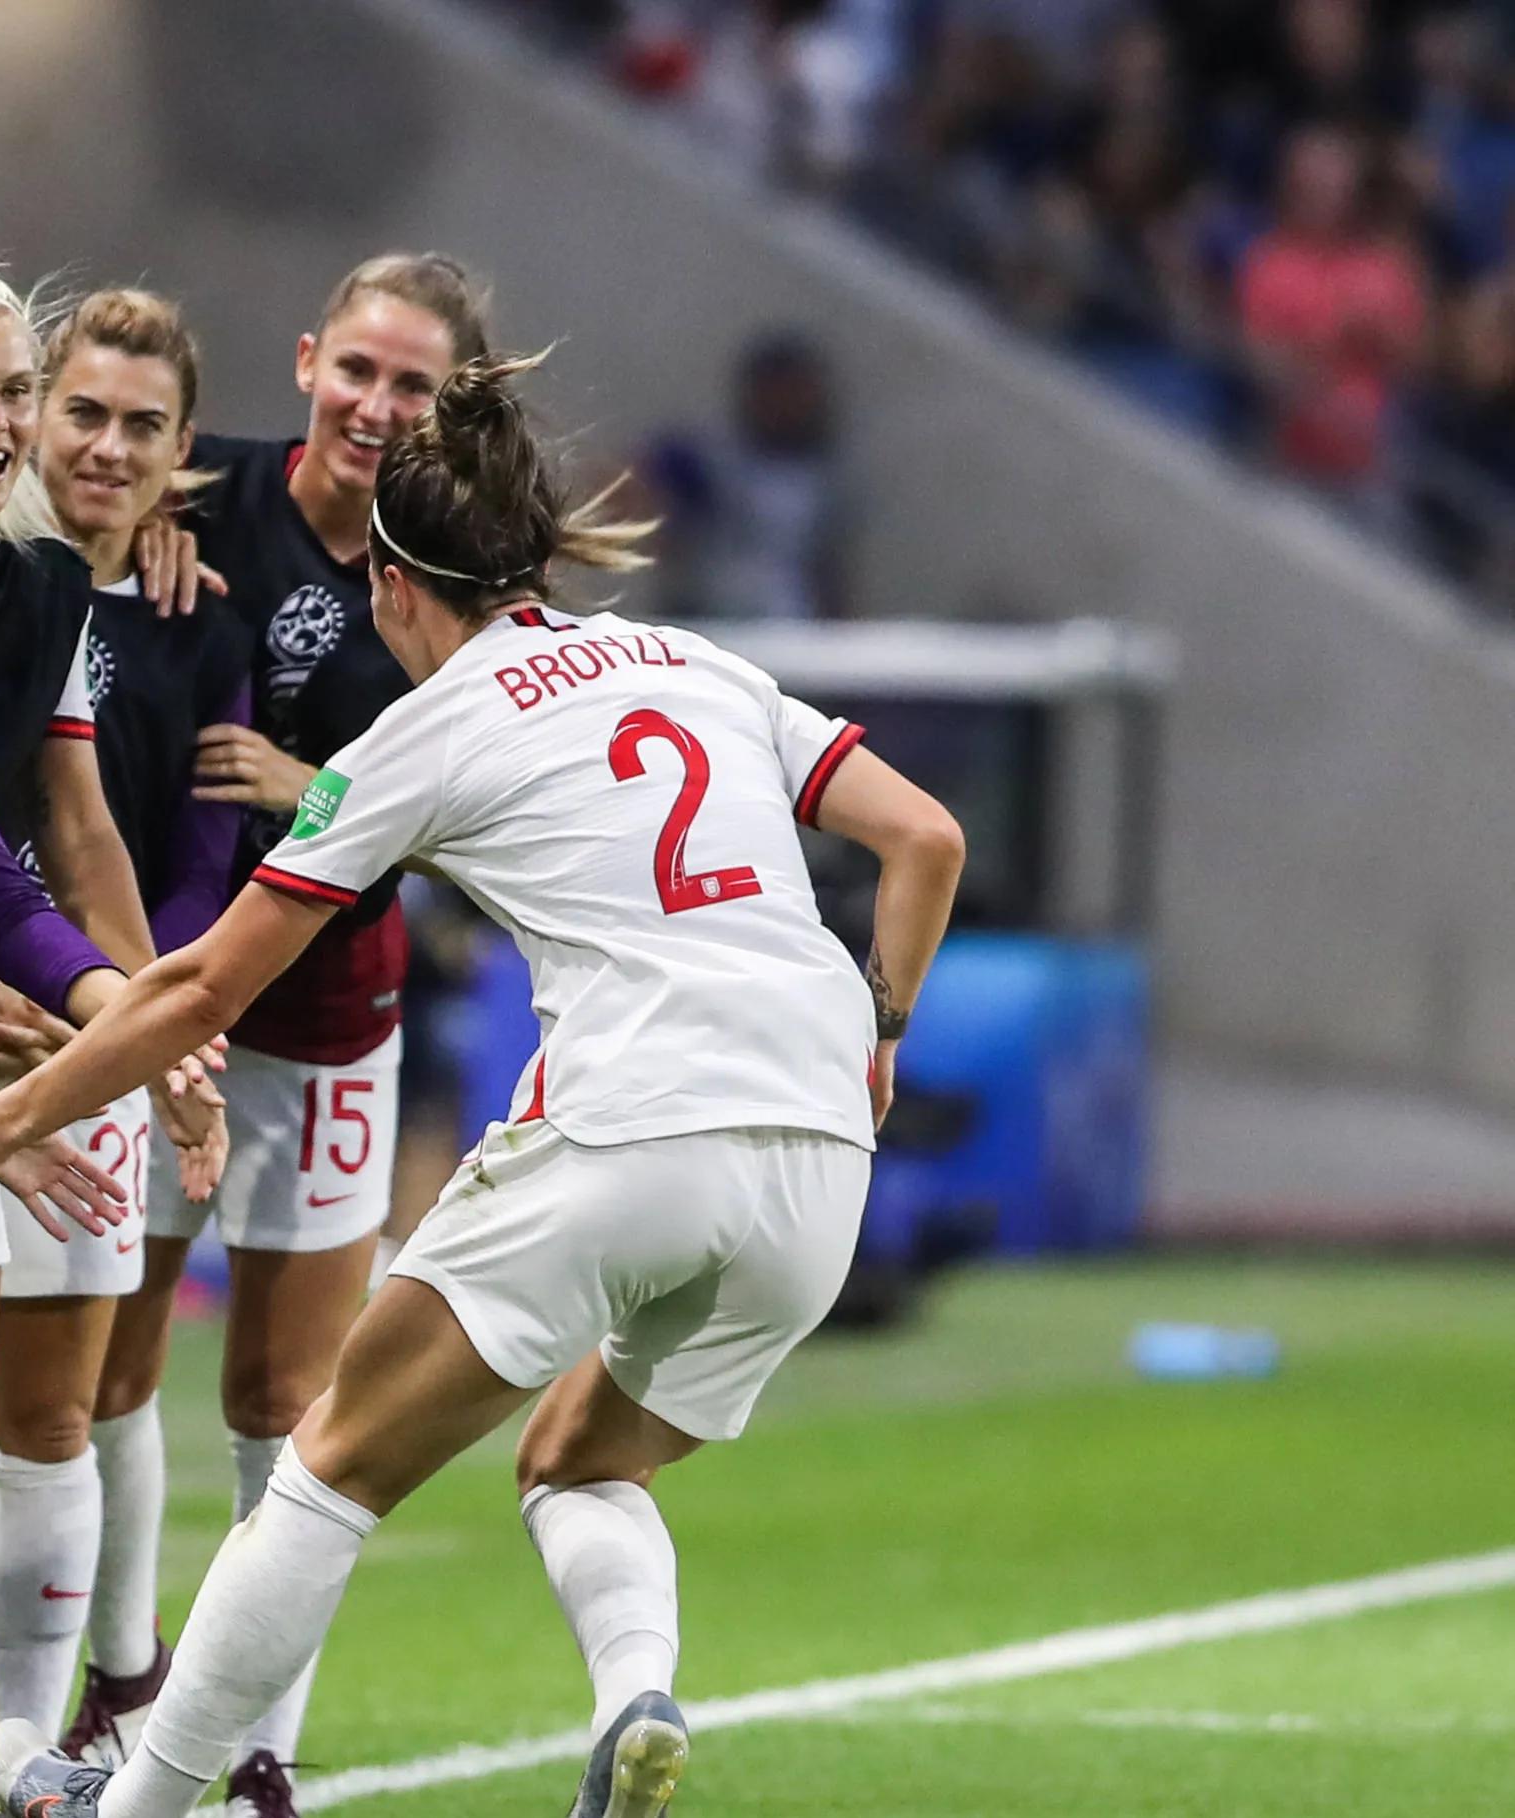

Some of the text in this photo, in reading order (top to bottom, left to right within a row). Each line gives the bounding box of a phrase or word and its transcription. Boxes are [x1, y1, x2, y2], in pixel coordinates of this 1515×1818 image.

[494, 631, 687, 711] BRONZE
[608, 708, 764, 915] 2
[299, 1078, 374, 1175] 15
